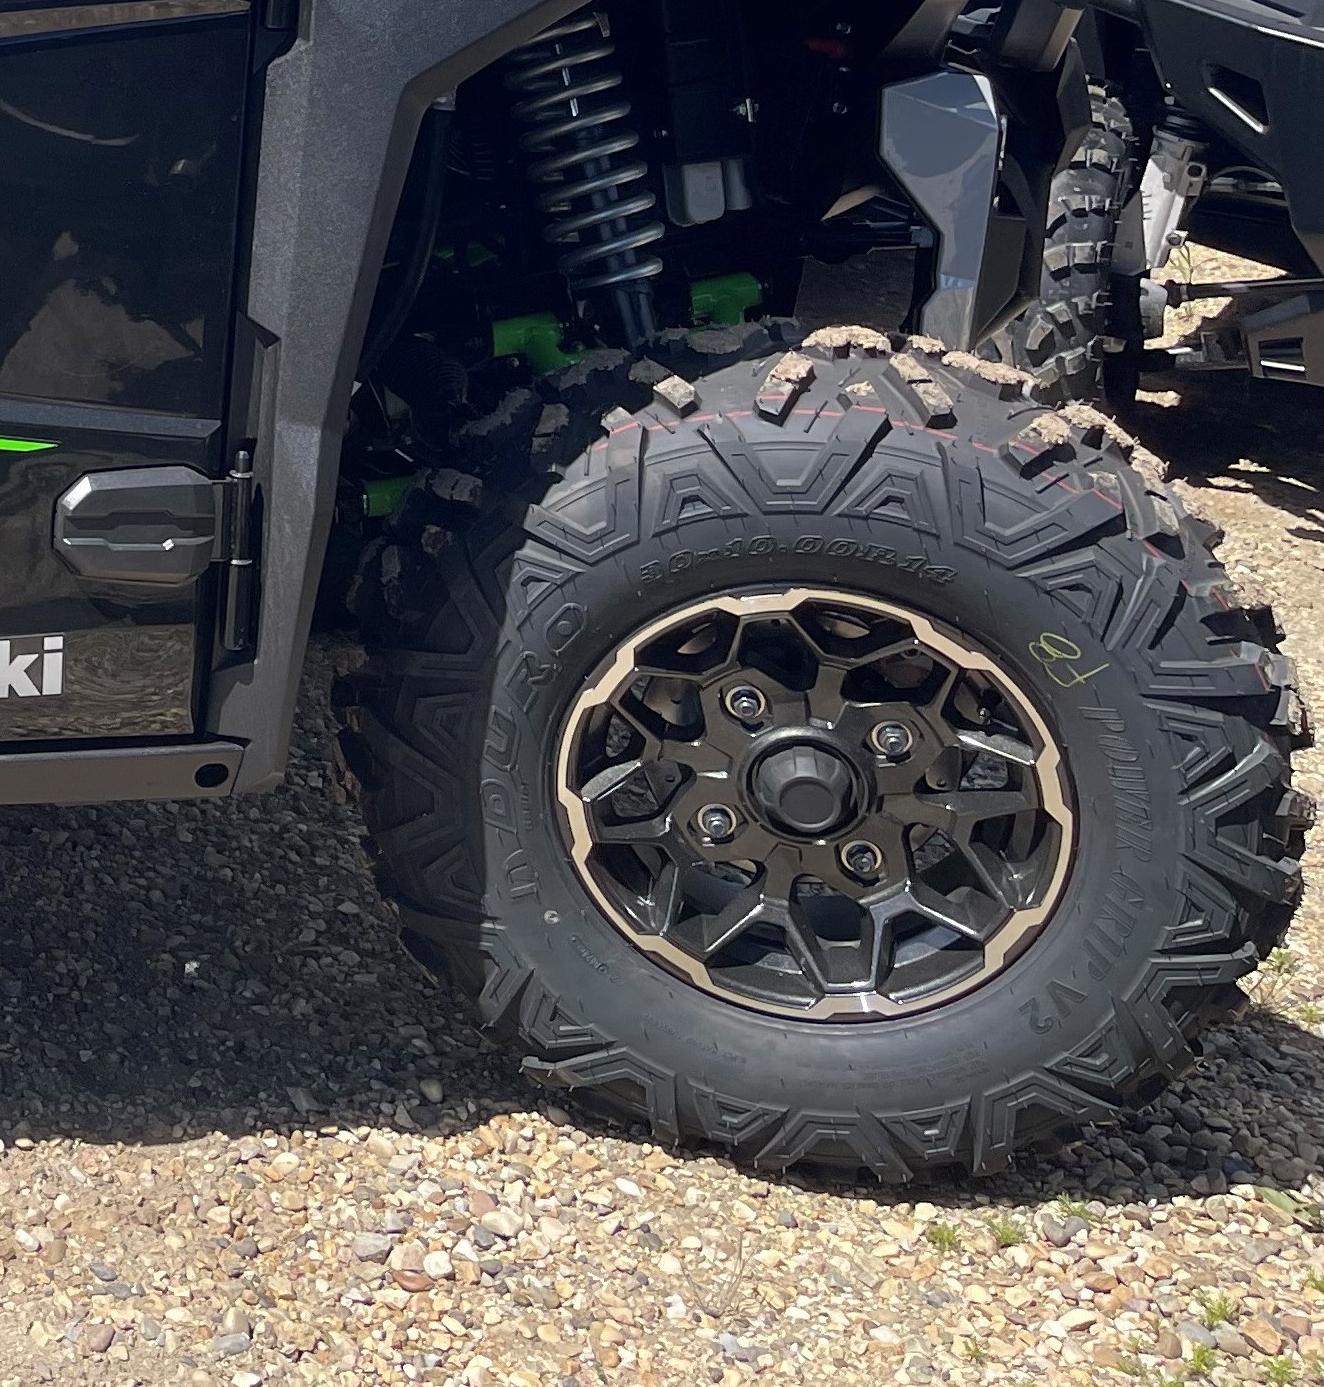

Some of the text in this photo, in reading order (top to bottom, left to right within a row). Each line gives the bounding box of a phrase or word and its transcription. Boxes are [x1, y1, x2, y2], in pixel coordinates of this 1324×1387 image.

[480, 602, 587, 834] DURO
[1018, 705, 1153, 1034] POWER GRIP V2
